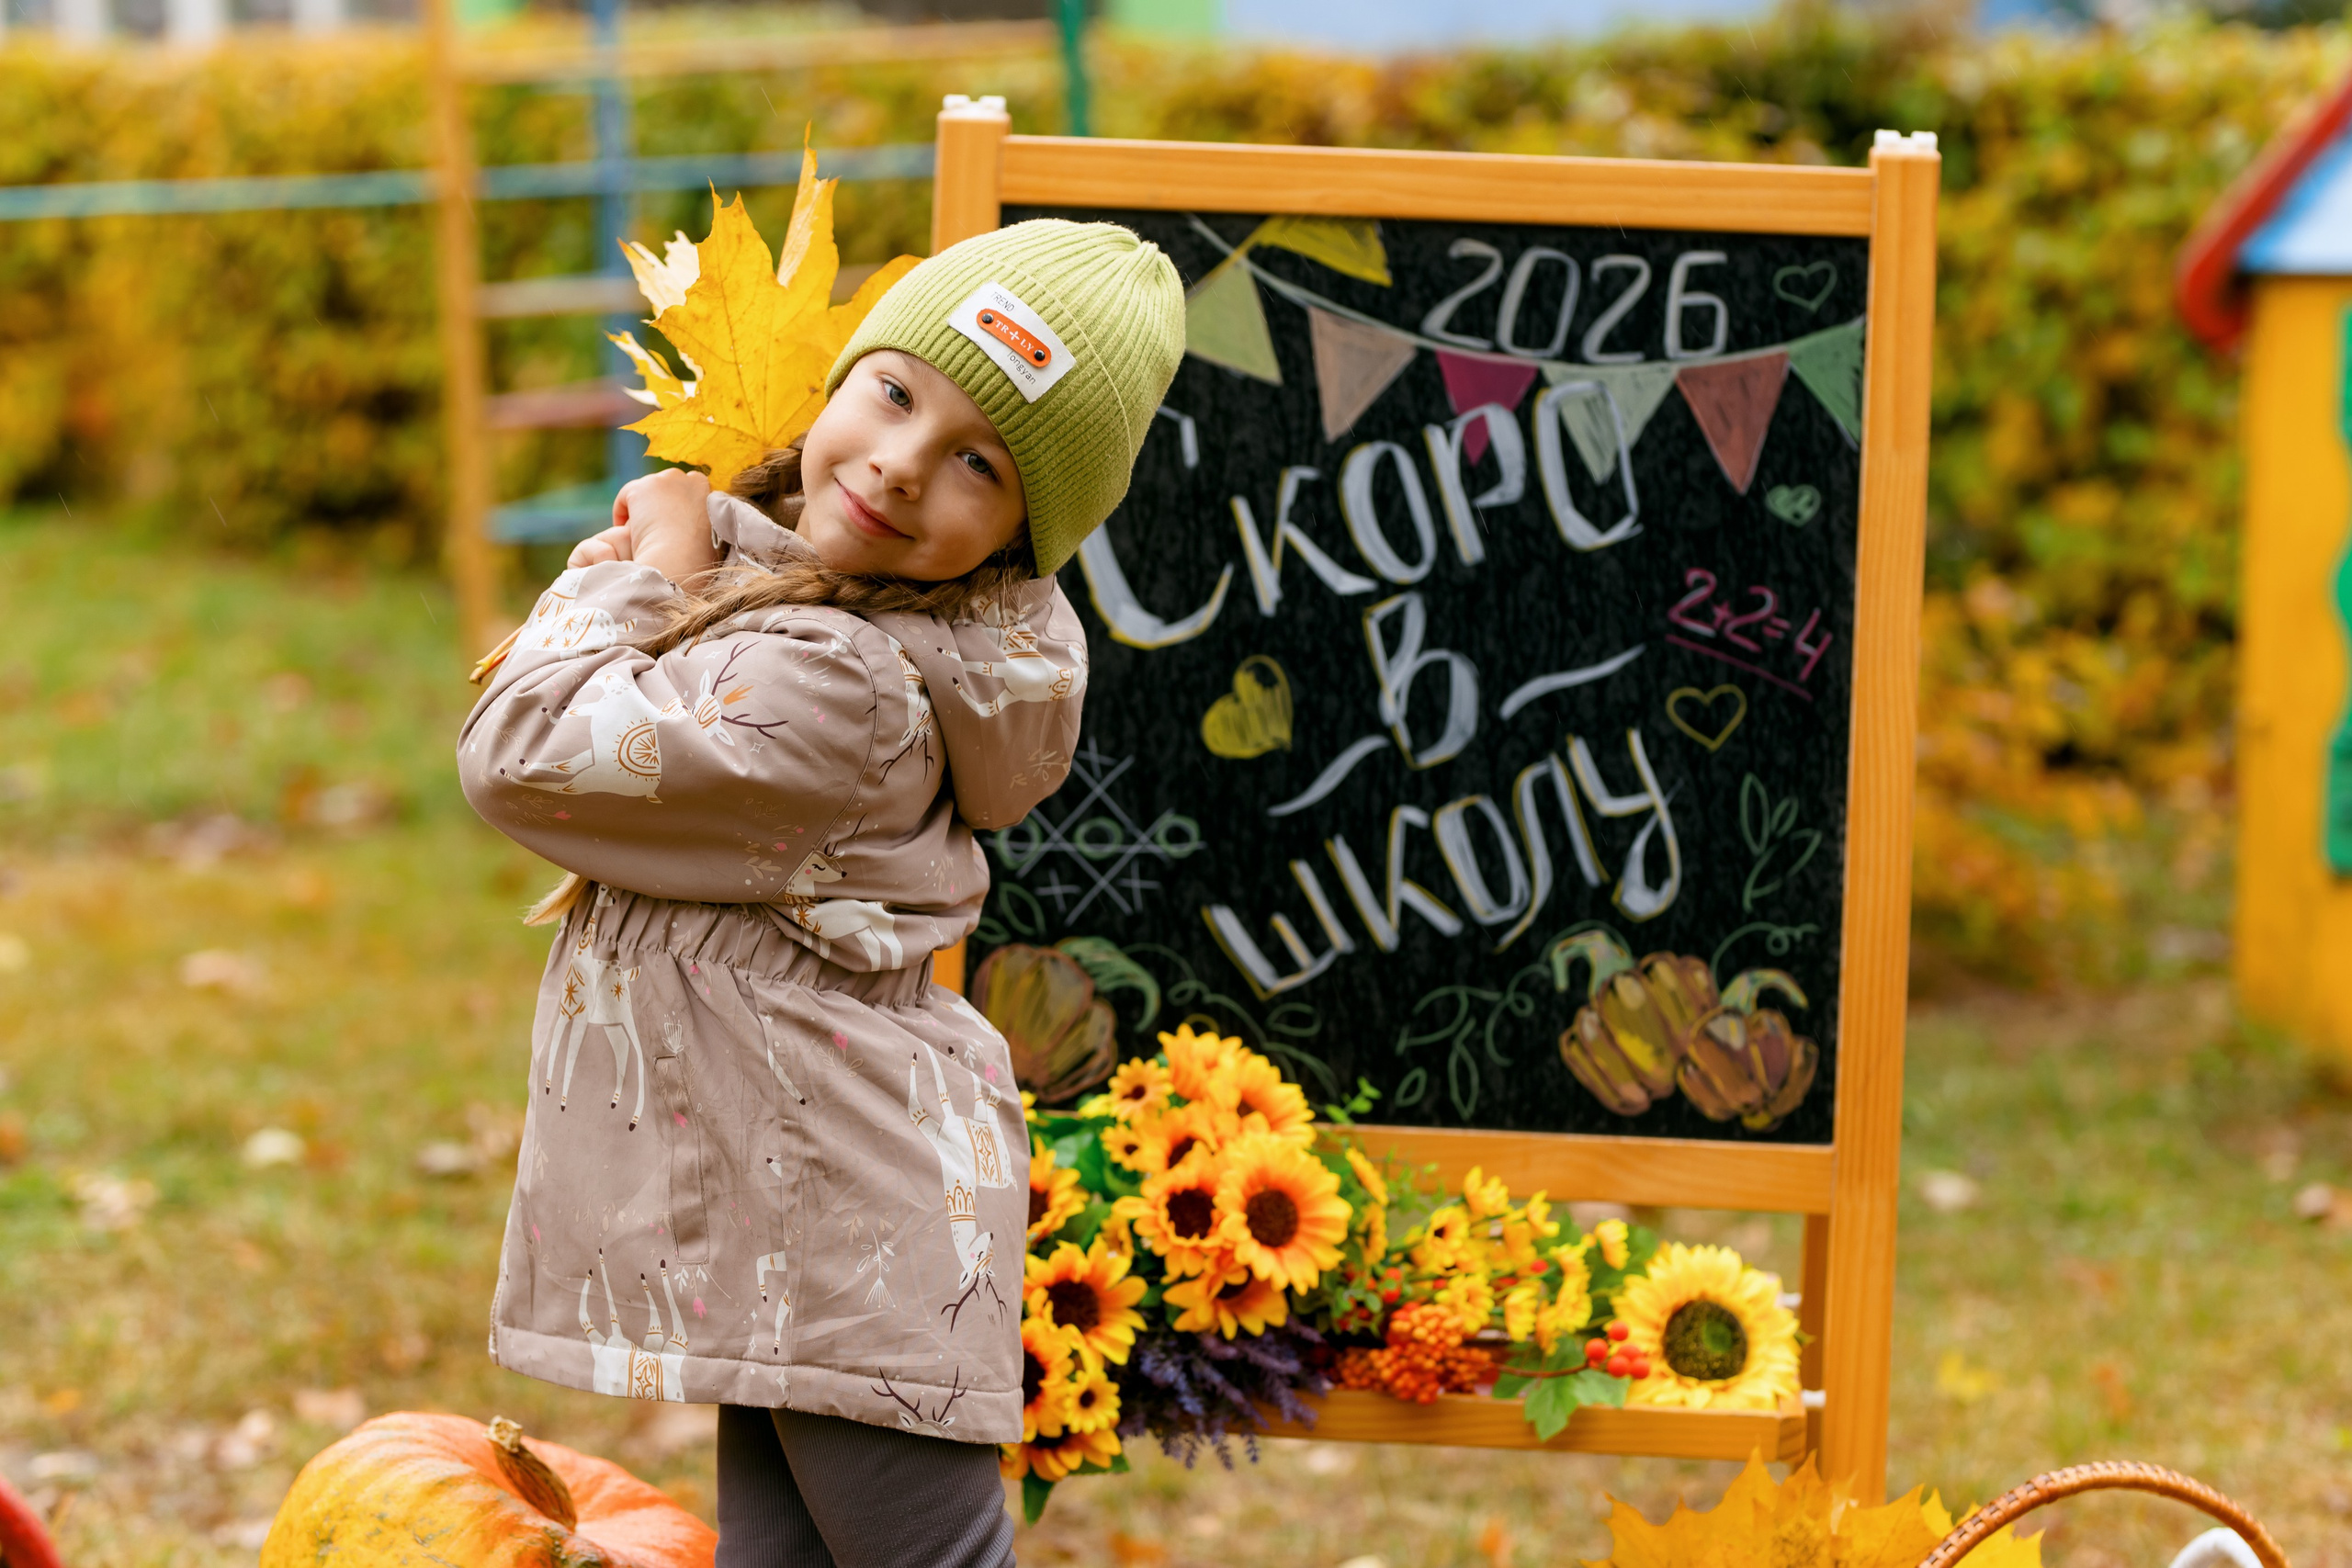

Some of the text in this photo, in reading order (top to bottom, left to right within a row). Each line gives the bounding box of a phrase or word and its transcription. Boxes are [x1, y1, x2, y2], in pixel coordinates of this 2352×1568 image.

[990, 291, 1015, 312] TREND
[1421, 237, 1729, 363] 2026
[1668, 567, 1834, 682] 2+2=4
